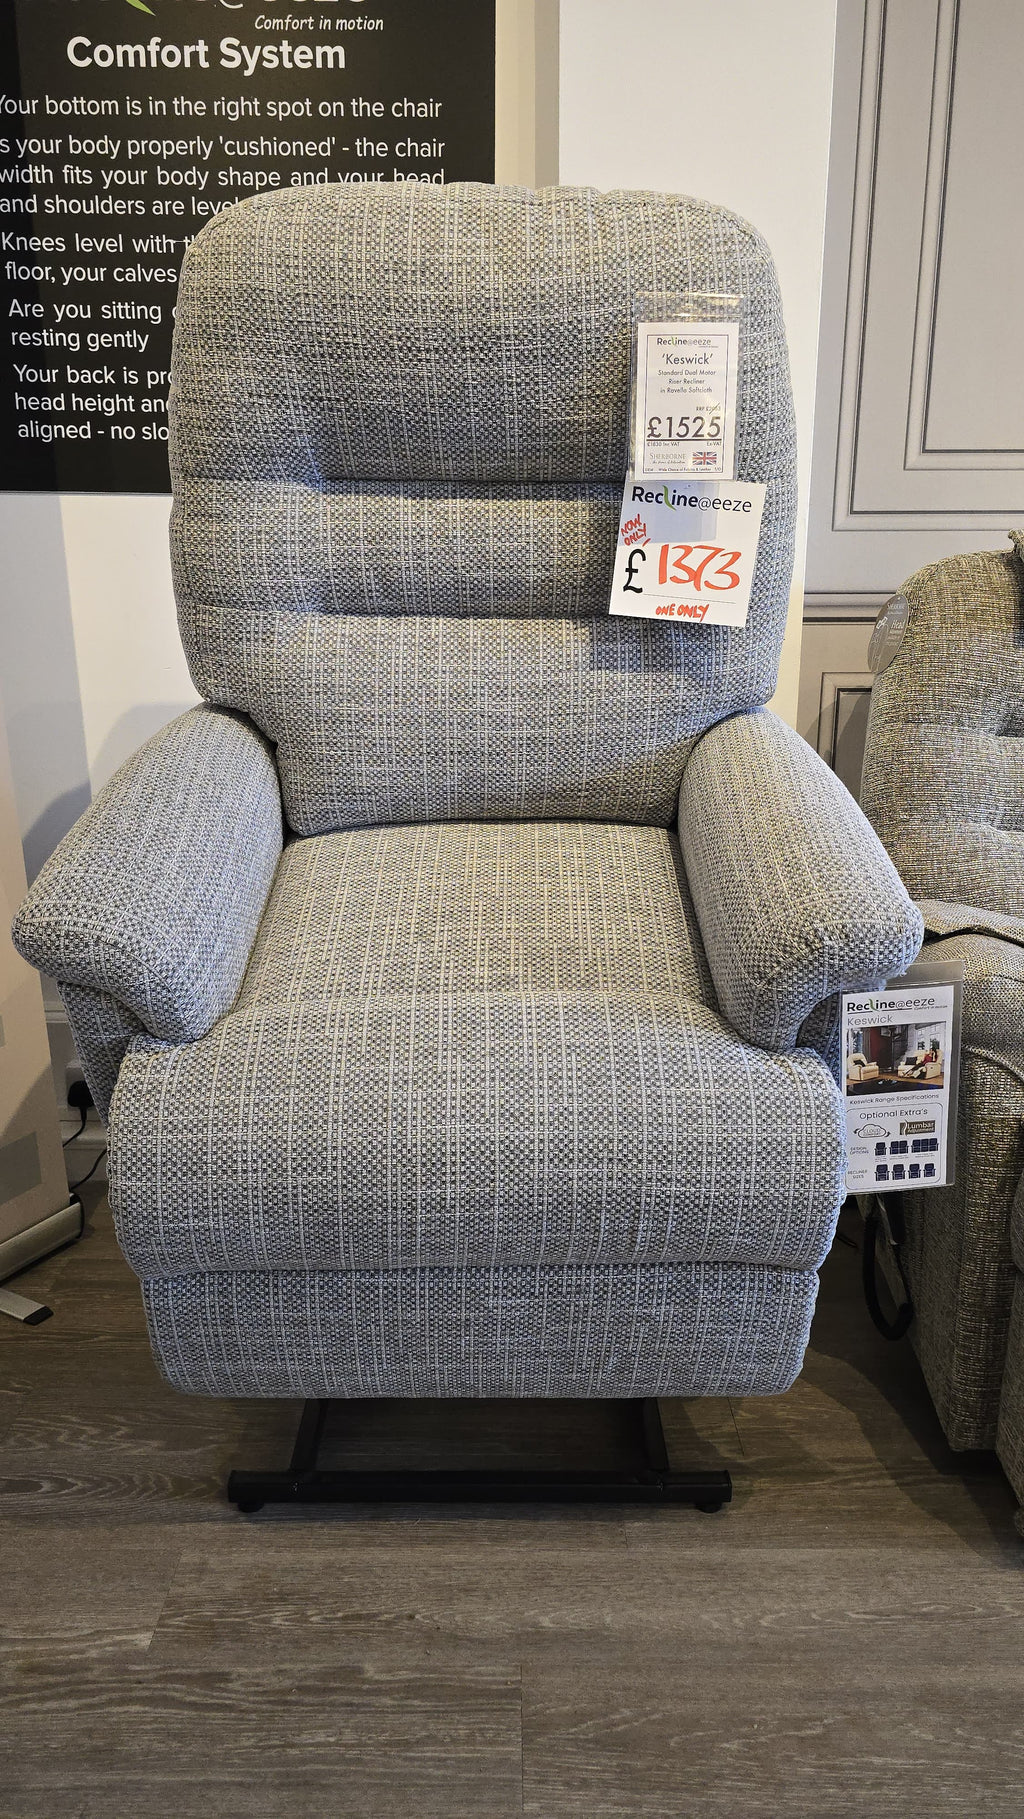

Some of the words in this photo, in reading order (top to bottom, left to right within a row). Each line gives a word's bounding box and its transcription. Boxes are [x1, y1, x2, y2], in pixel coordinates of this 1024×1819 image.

[254, 14, 314, 31] Comfort
[319, 16, 331, 31] in
[336, 16, 384, 31] motion
[66, 36, 210, 68] Comfort
[220, 37, 346, 76] System
[45, 95, 119, 116] bottom
[126, 96, 142, 116] is
[149, 96, 166, 116] in
[173, 96, 206, 116] the
[213, 96, 260, 122] right
[266, 98, 312, 122] spot
[318, 100, 344, 117] on
[350, 98, 384, 118] the
[391, 98, 442, 118] chair
[0, 138, 10, 154] s
[16, 138, 62, 158] your
[68, 134, 121, 159] body
[127, 136, 214, 160] properly
[219, 136, 336, 156] 'cushioned'
[355, 137, 388, 157] the
[395, 138, 446, 158] chair
[0, 164, 54, 184] width
[62, 164, 93, 184] fits
[100, 169, 148, 189] your
[156, 166, 209, 190] body
[218, 166, 281, 190] shape
[290, 168, 328, 186] and
[338, 170, 384, 183] your
[394, 168, 444, 185] head
[0, 194, 37, 214] and
[44, 194, 146, 215] shoulders
[152, 200, 184, 216] are
[1, 232, 66, 252] Knees
[75, 232, 123, 253] level
[132, 234, 174, 253] with
[4, 261, 56, 284] floor,
[60, 266, 108, 286] your
[113, 264, 178, 283] calves
[8, 298, 44, 318] Are
[53, 304, 92, 322] you
[101, 300, 162, 324] sitting
[11, 328, 80, 352] resting
[86, 329, 149, 352] gently
[13, 364, 58, 383] Your
[66, 365, 116, 384] back
[123, 366, 139, 384] is
[14, 392, 66, 411] head
[72, 392, 136, 416] height
[140, 398, 169, 412] an
[18, 420, 92, 442] aligned
[110, 424, 136, 440] no
[646, 416, 721, 438] £1525
[620, 514, 642, 536] NOW
[624, 523, 647, 546] ONLY
[622, 548, 646, 594] £
[658, 544, 742, 591] 1373
[655, 604, 675, 616] ONE
[677, 604, 710, 622] ONLY
[848, 1014, 893, 1026] Keswick
[896, 1094, 939, 1102] Specifications
[860, 1110, 898, 1120] Optional
[900, 1108, 928, 1116] Extra's
